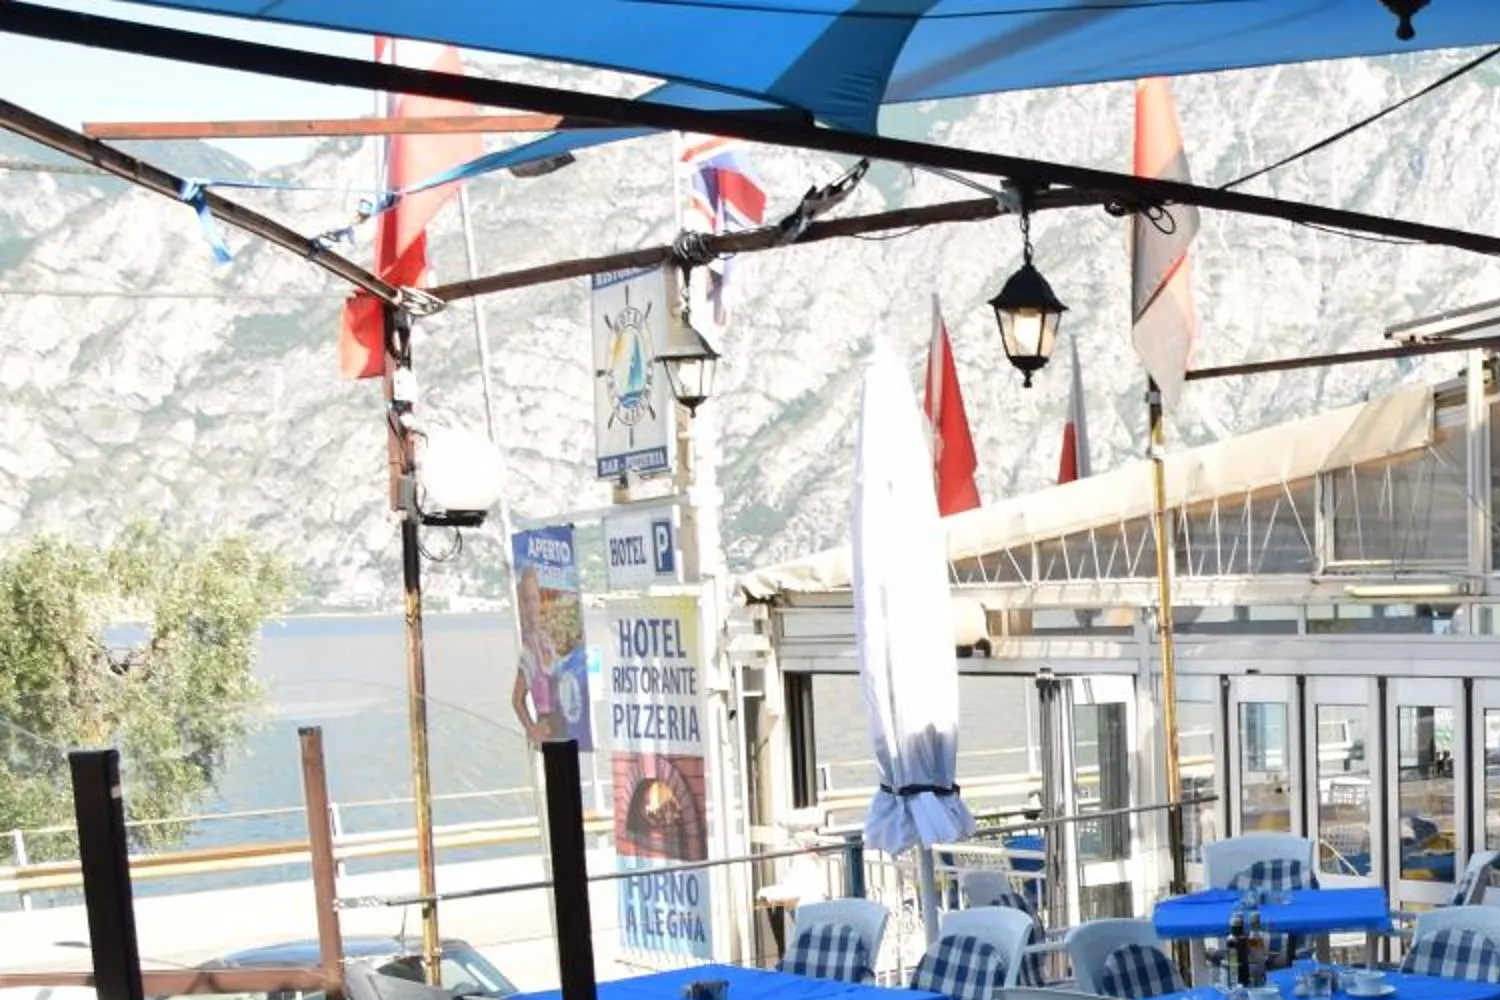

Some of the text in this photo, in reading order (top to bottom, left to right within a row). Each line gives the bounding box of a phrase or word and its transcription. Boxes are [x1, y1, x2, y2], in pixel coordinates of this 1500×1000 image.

[609, 525, 669, 569] HOTEL P
[618, 618, 687, 659] HOTEL
[612, 666, 697, 695] RISTORANTE
[612, 703, 701, 742] PIZZERIA
[627, 871, 699, 907] FORNO
[625, 904, 706, 942] A LEGNA
